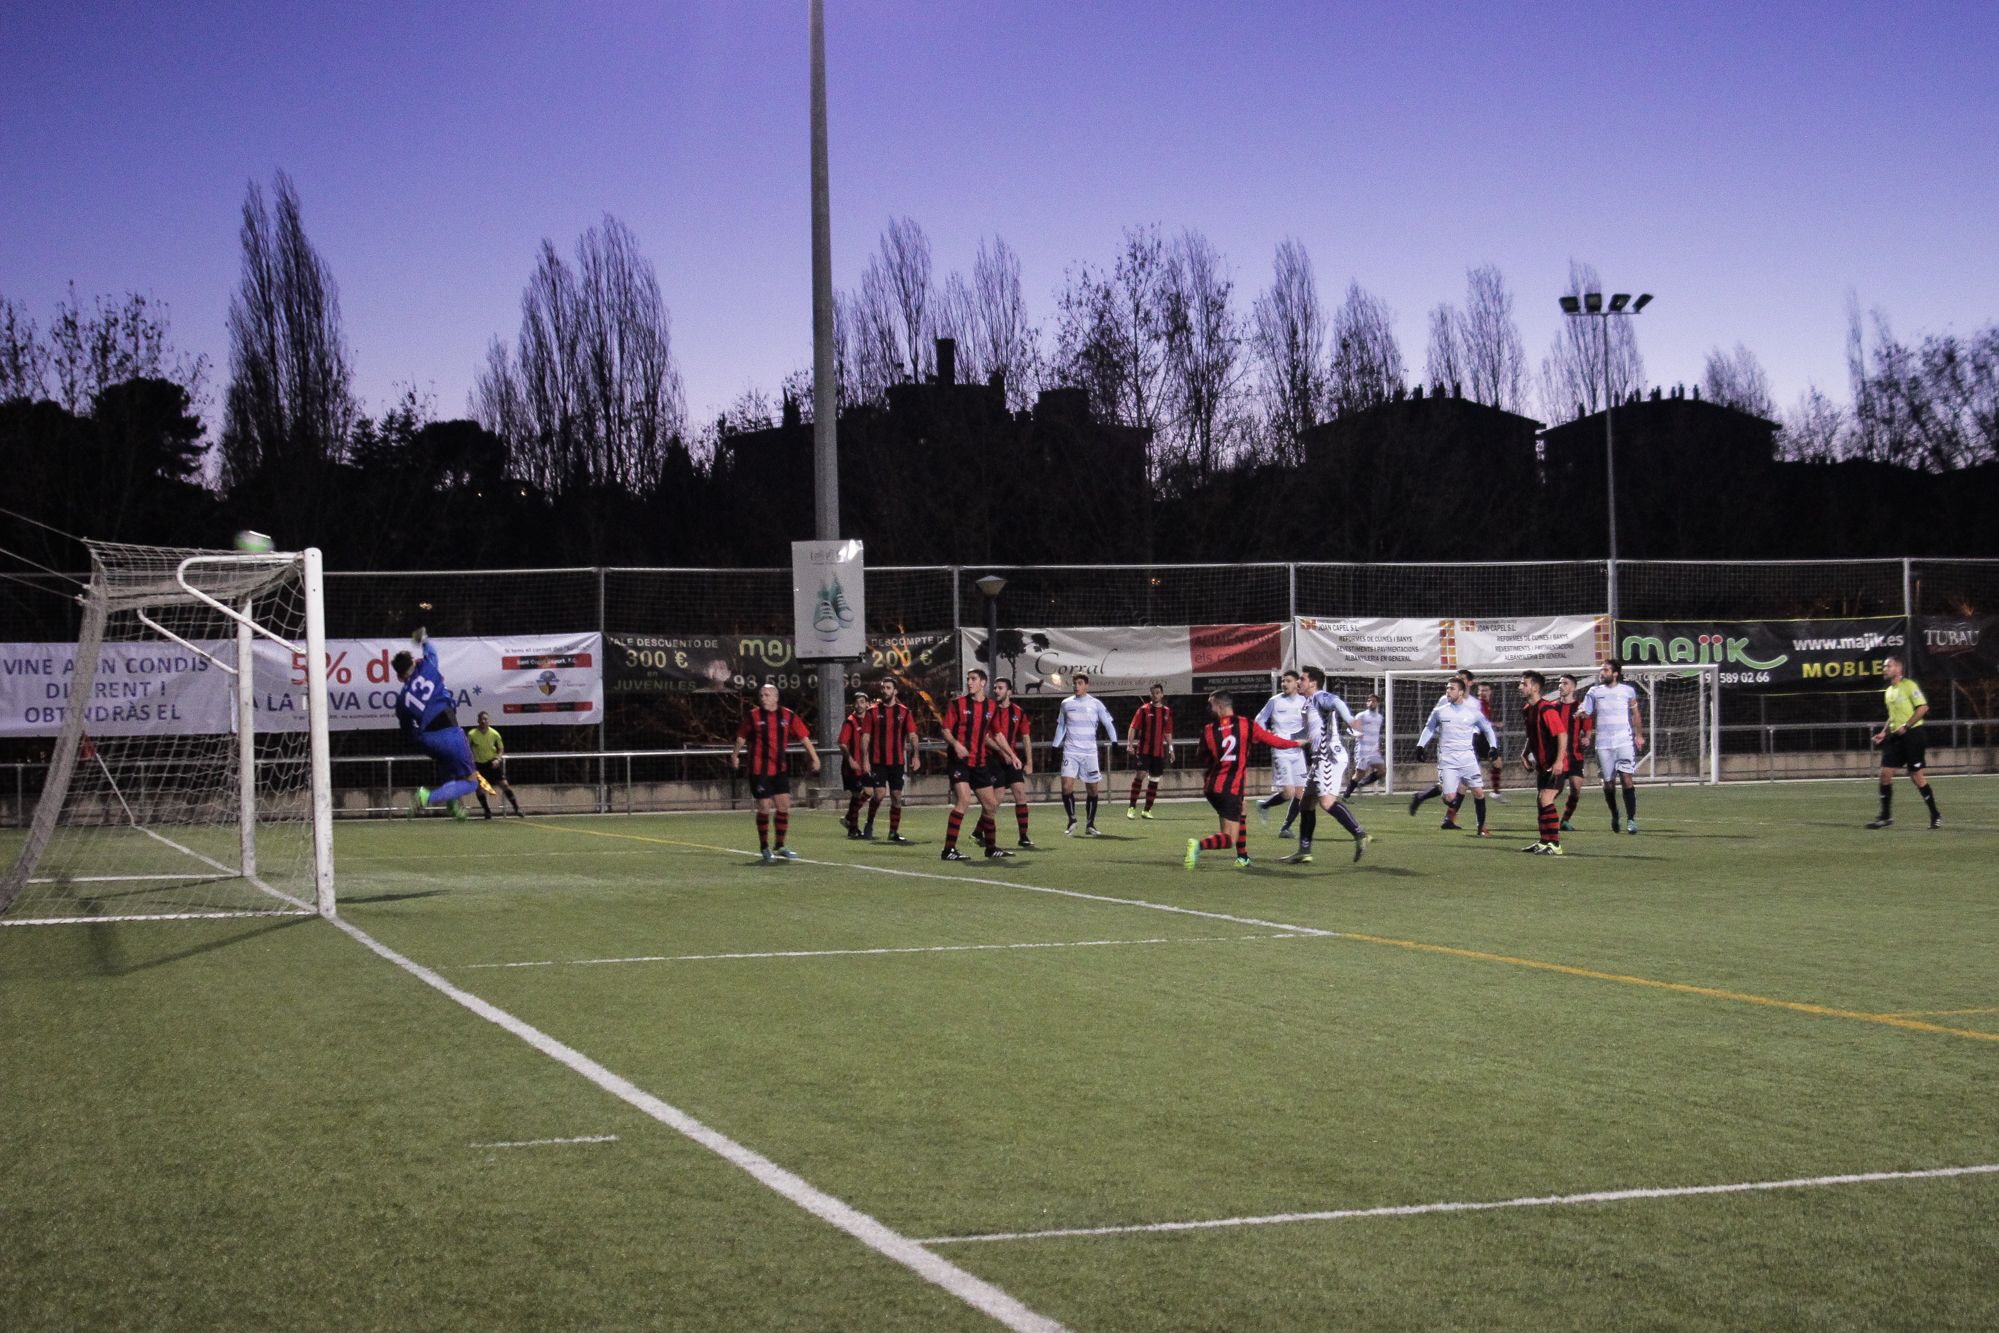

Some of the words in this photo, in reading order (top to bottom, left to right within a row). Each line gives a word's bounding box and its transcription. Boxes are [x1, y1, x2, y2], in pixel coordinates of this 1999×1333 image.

[637, 638, 701, 648] DESCUENTO
[704, 640, 718, 648] DE
[871, 636, 934, 647] DESCOMPTE
[1792, 632, 1904, 651] www.majik.es
[1923, 629, 1980, 646] TUBAU
[3, 659, 52, 675] VINE
[125, 656, 209, 674] CONDIS
[625, 649, 667, 668] 300
[674, 650, 689, 669] €
[872, 649, 911, 668] 200
[919, 648, 933, 666] €
[1035, 648, 1118, 675] Corral
[290, 651, 352, 685] 5%
[1720, 672, 1738, 683] 589
[1740, 672, 1754, 683] 02
[1756, 671, 1770, 682] 66
[1801, 659, 1884, 678] MOBLE
[46, 681, 151, 699] DIRENT
[613, 679, 697, 691] JUVENILES
[733, 674, 757, 689] 93
[765, 674, 801, 689] 589
[267, 693, 294, 712] LA
[405, 675, 435, 712] 13
[157, 703, 182, 720] EL
[1220, 734, 1237, 762] 2
